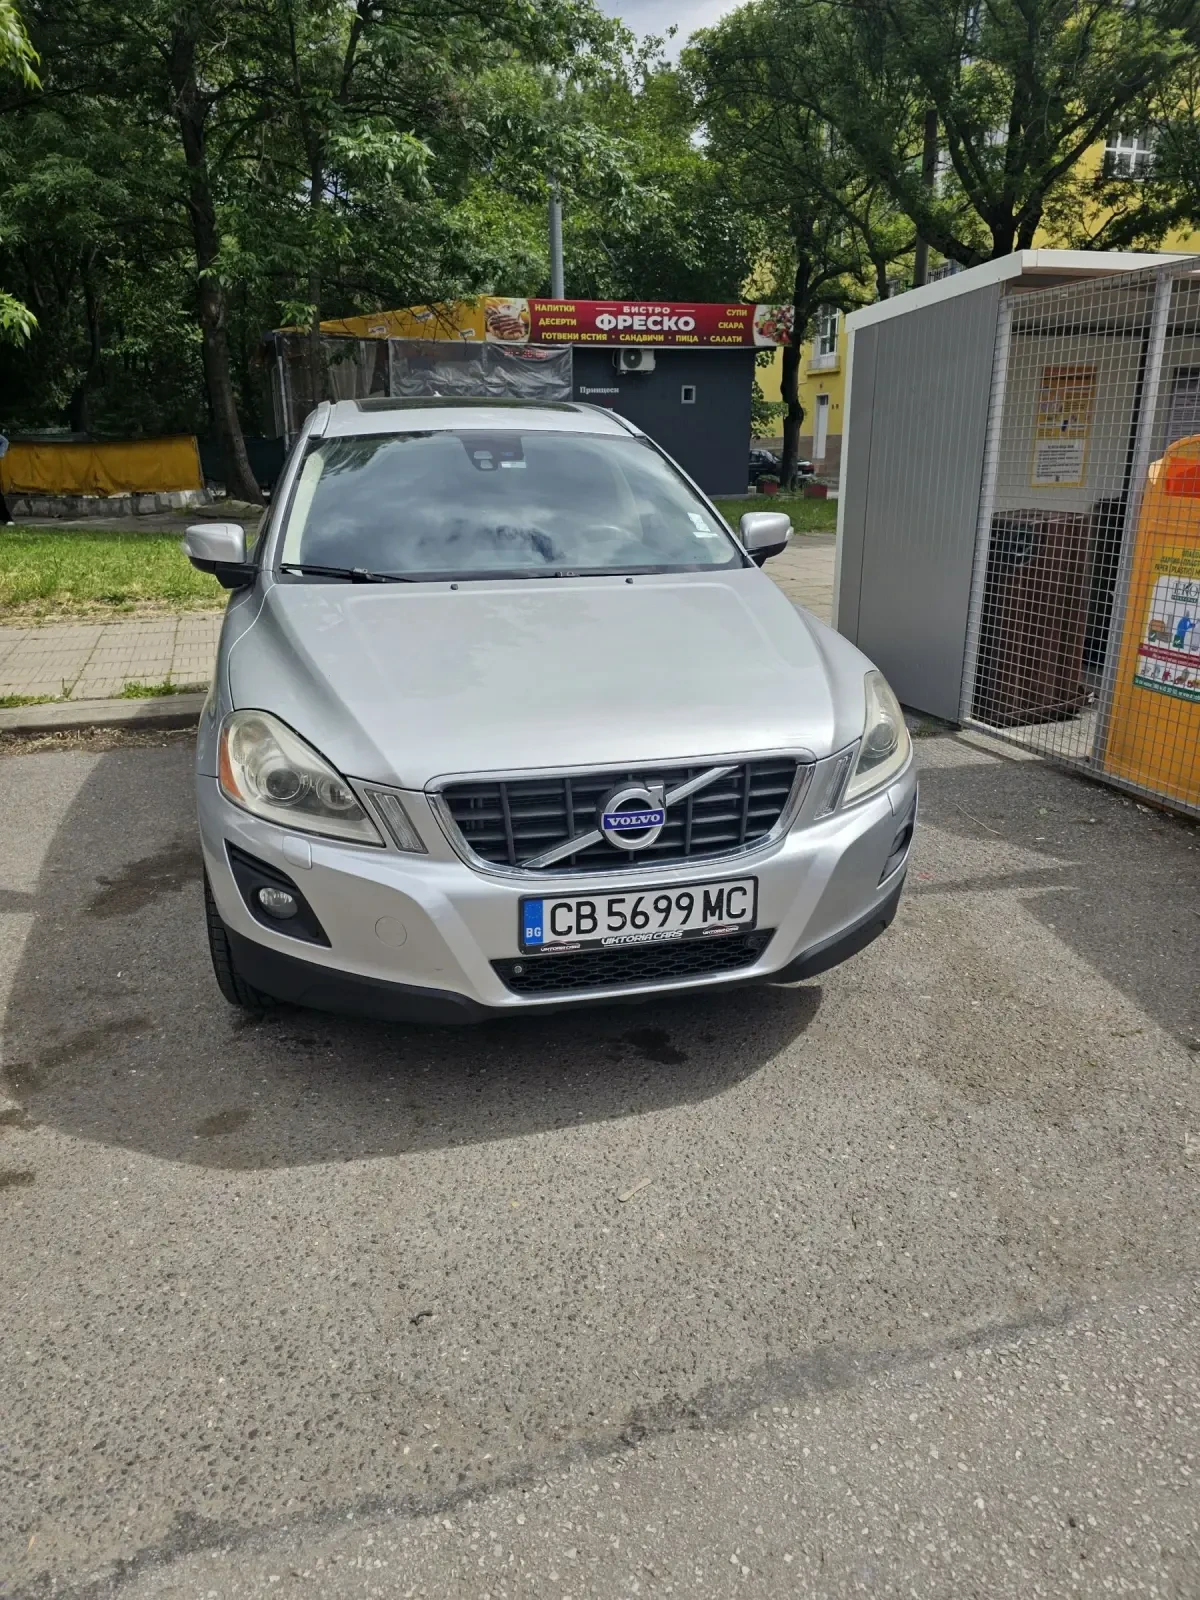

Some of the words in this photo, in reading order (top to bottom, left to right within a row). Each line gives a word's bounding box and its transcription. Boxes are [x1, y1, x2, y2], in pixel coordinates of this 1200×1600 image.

[535, 304, 575, 312] НАПИТКИ
[623, 306, 670, 314] БИСТРО
[539, 317, 576, 326] ДЕСЕРТИ
[595, 313, 695, 331] ФРЕСКО
[718, 321, 744, 329] СКАРА
[542, 332, 579, 340] ГОТВЕНИ
[619, 334, 664, 342] САНДВИЧИ
[675, 335, 698, 343] ПИЦА
[710, 335, 742, 343] САЛАТИ
[607, 814, 660, 826] VOLVO
[551, 901, 598, 936] CB
[607, 892, 694, 931] 5699
[702, 886, 747, 922] MC
[526, 927, 541, 937] BG
[653, 929, 684, 939] CARS
